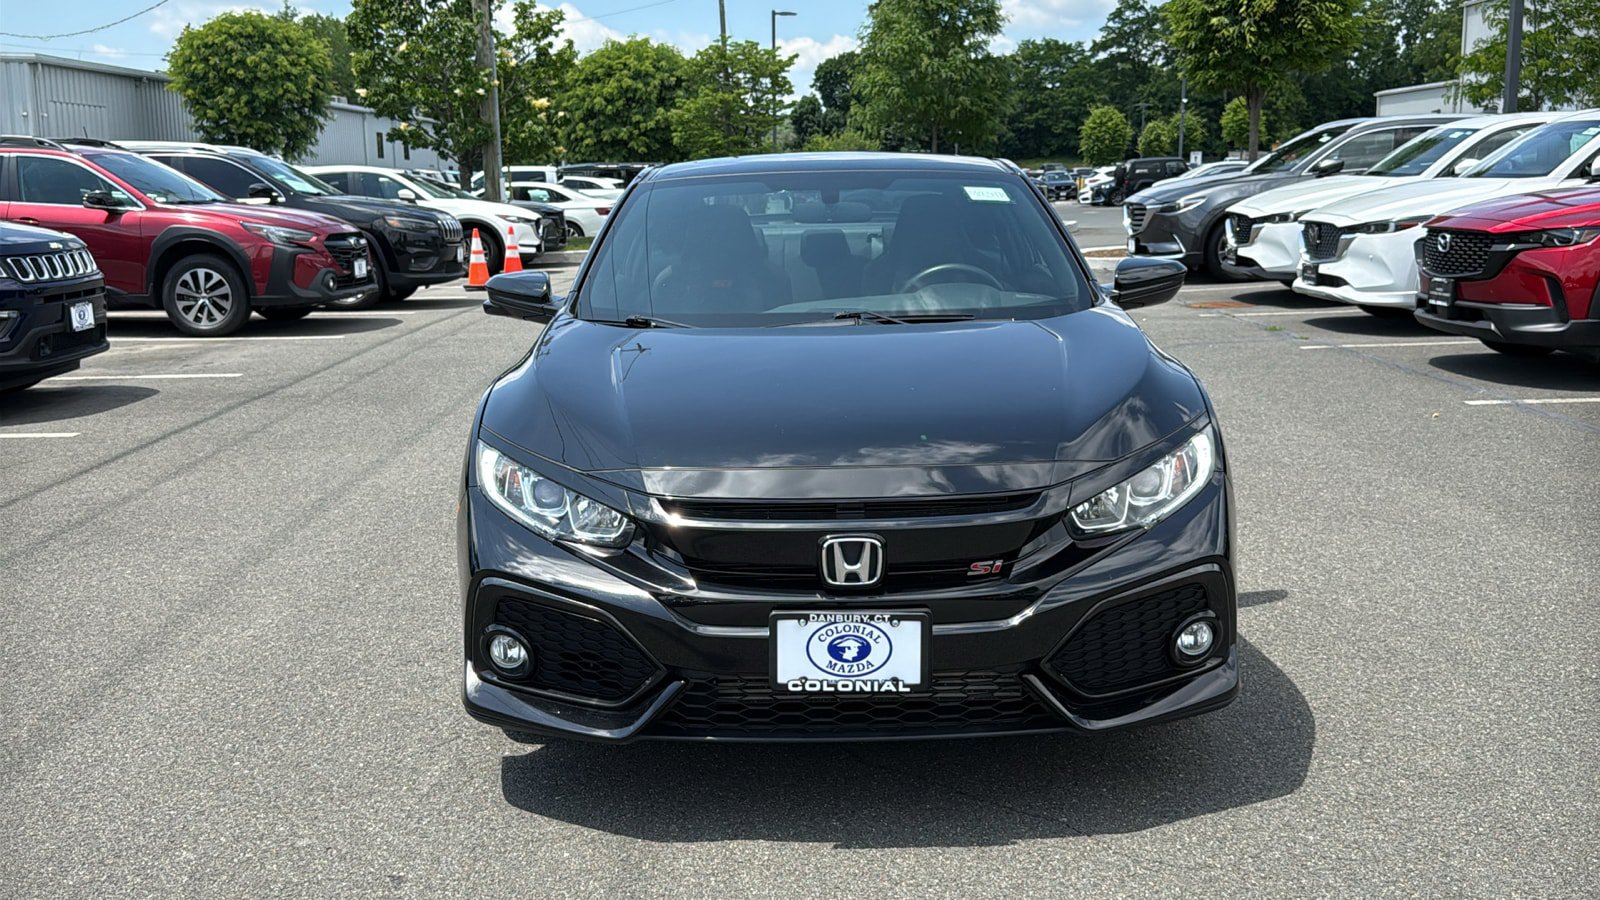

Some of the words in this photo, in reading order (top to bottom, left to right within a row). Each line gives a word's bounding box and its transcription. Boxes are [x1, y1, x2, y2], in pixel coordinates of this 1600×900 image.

[809, 613, 871, 623] DANBURY,
[874, 614, 891, 623] CT
[818, 624, 881, 644] COLONIAL
[826, 660, 875, 674] MAZDA
[787, 680, 911, 692] COLONIAL
